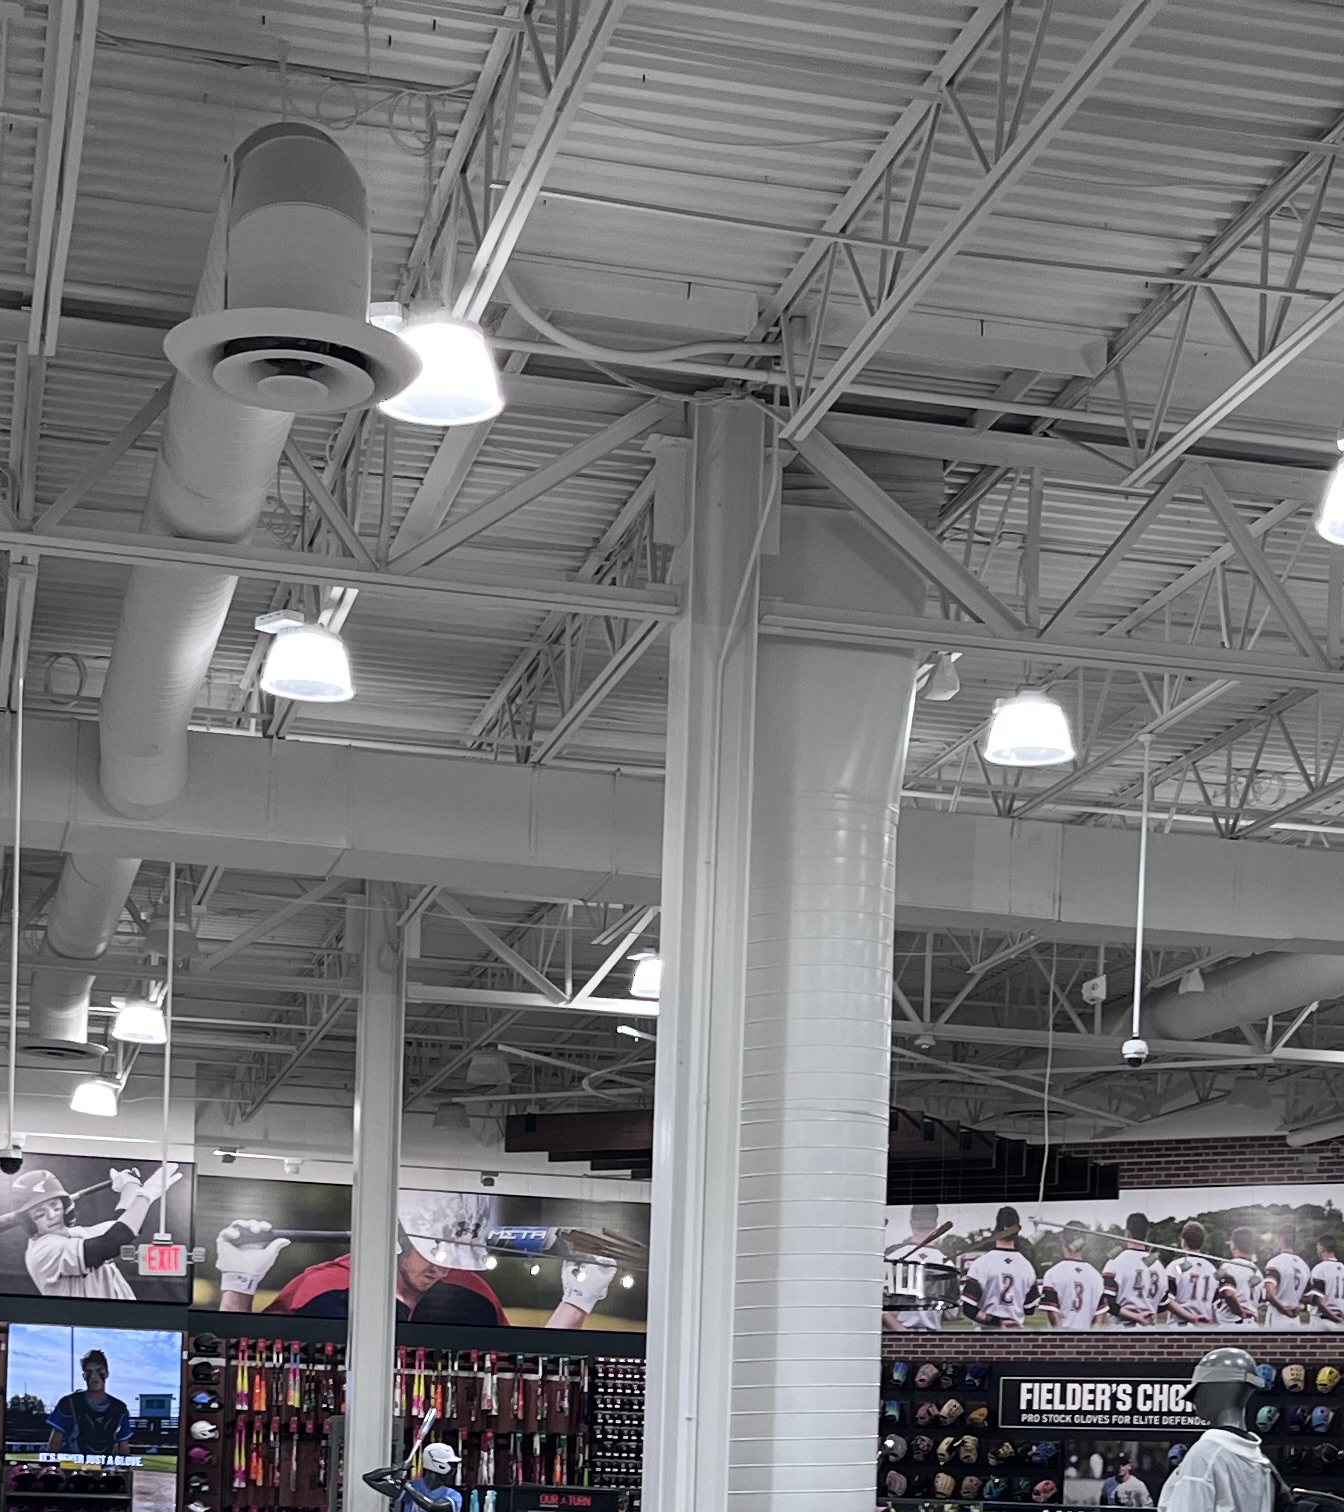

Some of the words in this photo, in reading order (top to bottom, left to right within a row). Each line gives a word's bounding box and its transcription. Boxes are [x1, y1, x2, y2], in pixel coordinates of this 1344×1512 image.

[147, 1246, 181, 1271] EXIT
[999, 1272, 1014, 1306] 2
[1069, 1280, 1084, 1312] 3
[1133, 1269, 1159, 1299] 43
[1190, 1272, 1211, 1303] 71
[1019, 1382, 1133, 1412] FIELDER'S
[1021, 1413, 1040, 1423] PRO
[1042, 1413, 1073, 1424] STOCK
[1074, 1414, 1110, 1424] GLOVES
[1112, 1415, 1131, 1425] FOR
[1133, 1415, 1160, 1425] ELITE
[1162, 1416, 1211, 1427] DEFEND
[539, 1492, 559, 1505] OUR
[568, 1494, 592, 1506] TURN
